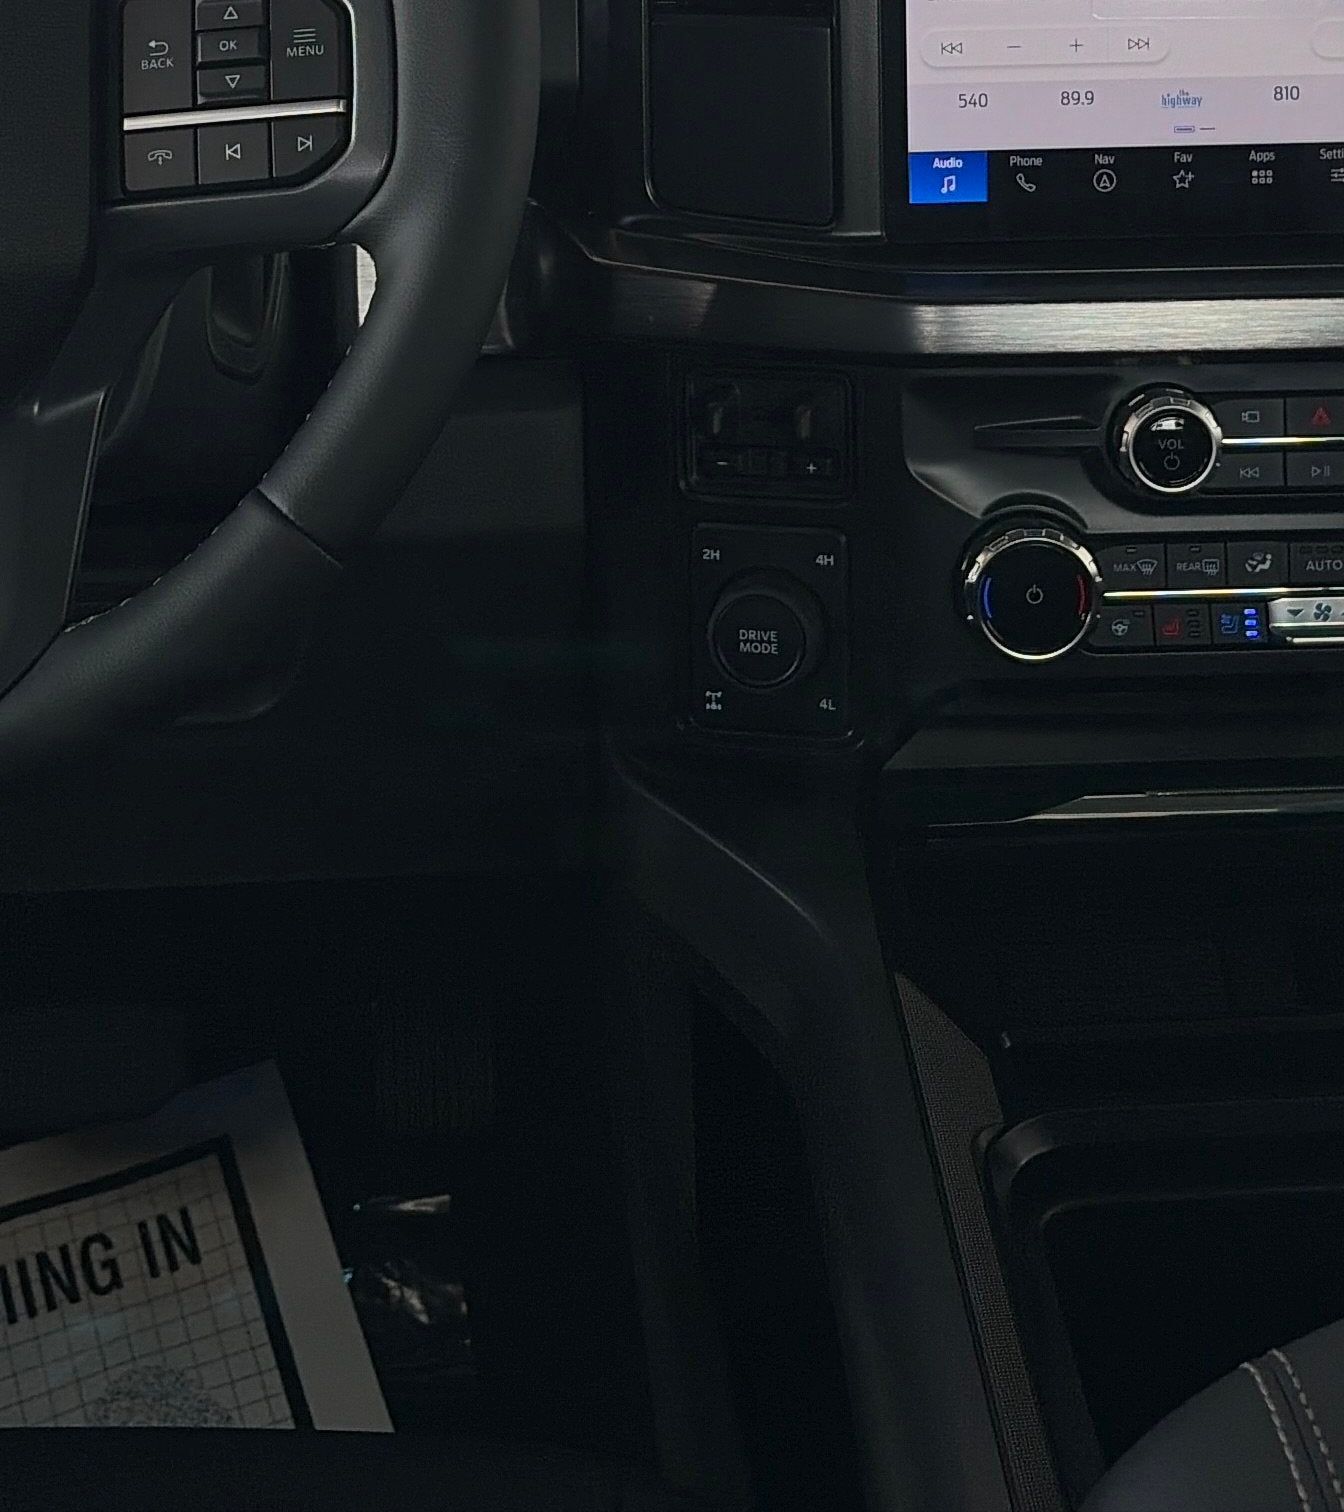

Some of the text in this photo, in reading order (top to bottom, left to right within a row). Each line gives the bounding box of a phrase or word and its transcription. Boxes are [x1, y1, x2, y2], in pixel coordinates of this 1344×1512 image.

[219, 39, 238, 52] OK
[286, 44, 325, 58] MENU
[140, 56, 175, 71] BACK
[1060, 90, 1095, 107] 89.9
[1273, 85, 1301, 101] 810
[958, 93, 989, 109] 540
[932, 156, 963, 169] Audio
[1009, 154, 1043, 168] Phone
[1094, 153, 1116, 165] Nav
[1173, 151, 1193, 164] Fav
[1249, 150, 1276, 166] Apps
[1157, 438, 1185, 450] VOL
[701, 548, 721, 562] 2H
[814, 554, 835, 567] 4H
[1112, 563, 1137, 573] MAX
[1176, 561, 1202, 572] REAR
[1306, 559, 1344, 572] AUTO
[738, 629, 778, 643] DRIVE
[738, 642, 779, 655] MODE
[818, 697, 836, 711] 4L
[137, 1206, 203, 1279] IN
